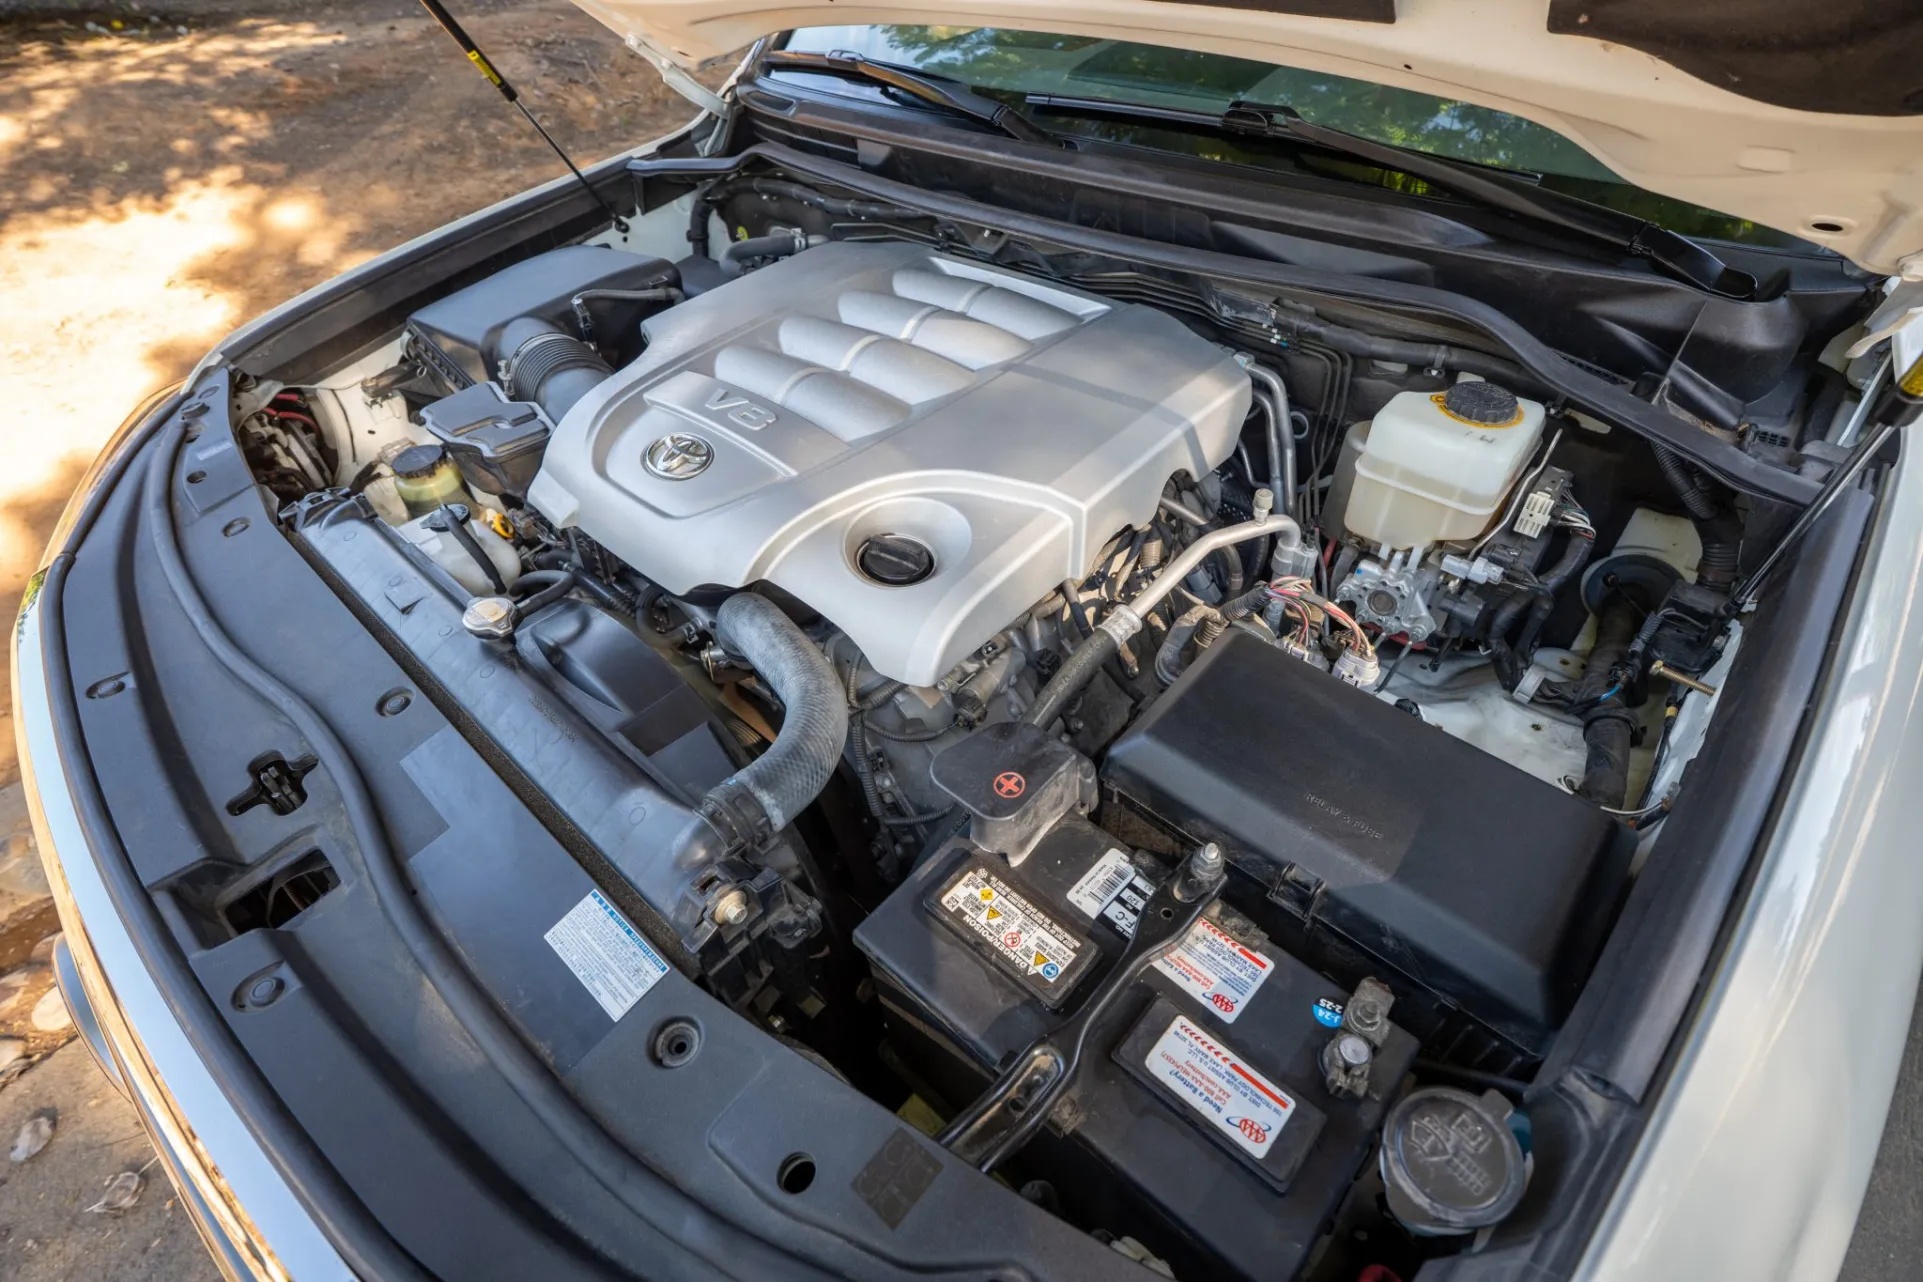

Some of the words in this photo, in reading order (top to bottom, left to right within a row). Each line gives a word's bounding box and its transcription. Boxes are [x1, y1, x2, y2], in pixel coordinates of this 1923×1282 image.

[705, 388, 778, 431] V8
[1305, 792, 1341, 816] RELAY
[1126, 894, 1138, 905] 120
[961, 913, 1028, 969] DANGER/POISON
[1220, 955, 1235, 967] CLUB
[1212, 993, 1234, 1013] AAA
[1207, 1063, 1226, 1080] ASSIST
[1209, 1057, 1223, 1069] LAKE
[1168, 1067, 1199, 1094] Battery?
[1224, 1077, 1240, 1092] CLUB
[1202, 1095, 1222, 1113] Need
[1213, 1093, 1227, 1106] Call
[1237, 1080, 1273, 1109] TECHNOLOGY
[1239, 1118, 1266, 1144] AAA
